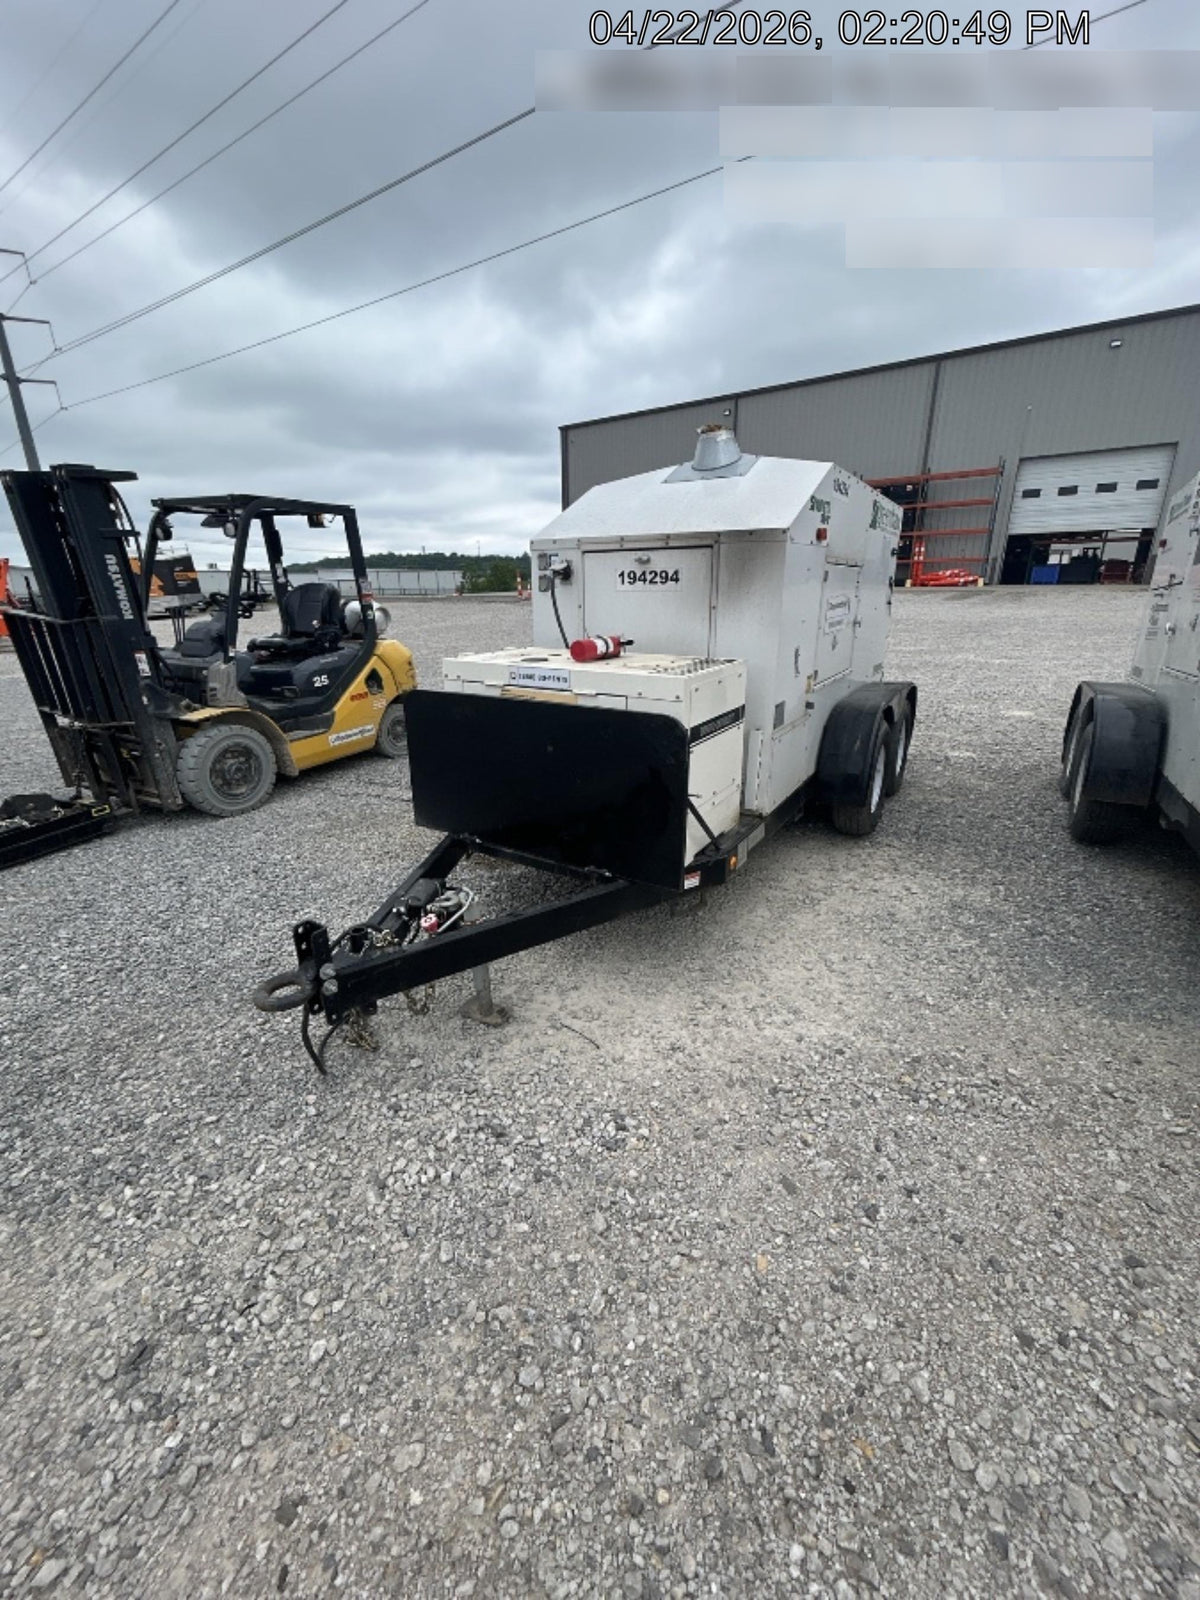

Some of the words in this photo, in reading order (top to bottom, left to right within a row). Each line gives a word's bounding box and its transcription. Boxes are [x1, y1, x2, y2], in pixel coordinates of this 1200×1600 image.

[618, 569, 680, 585] 194294
[104, 553, 134, 620] KOMATSU
[312, 674, 330, 687] 25
